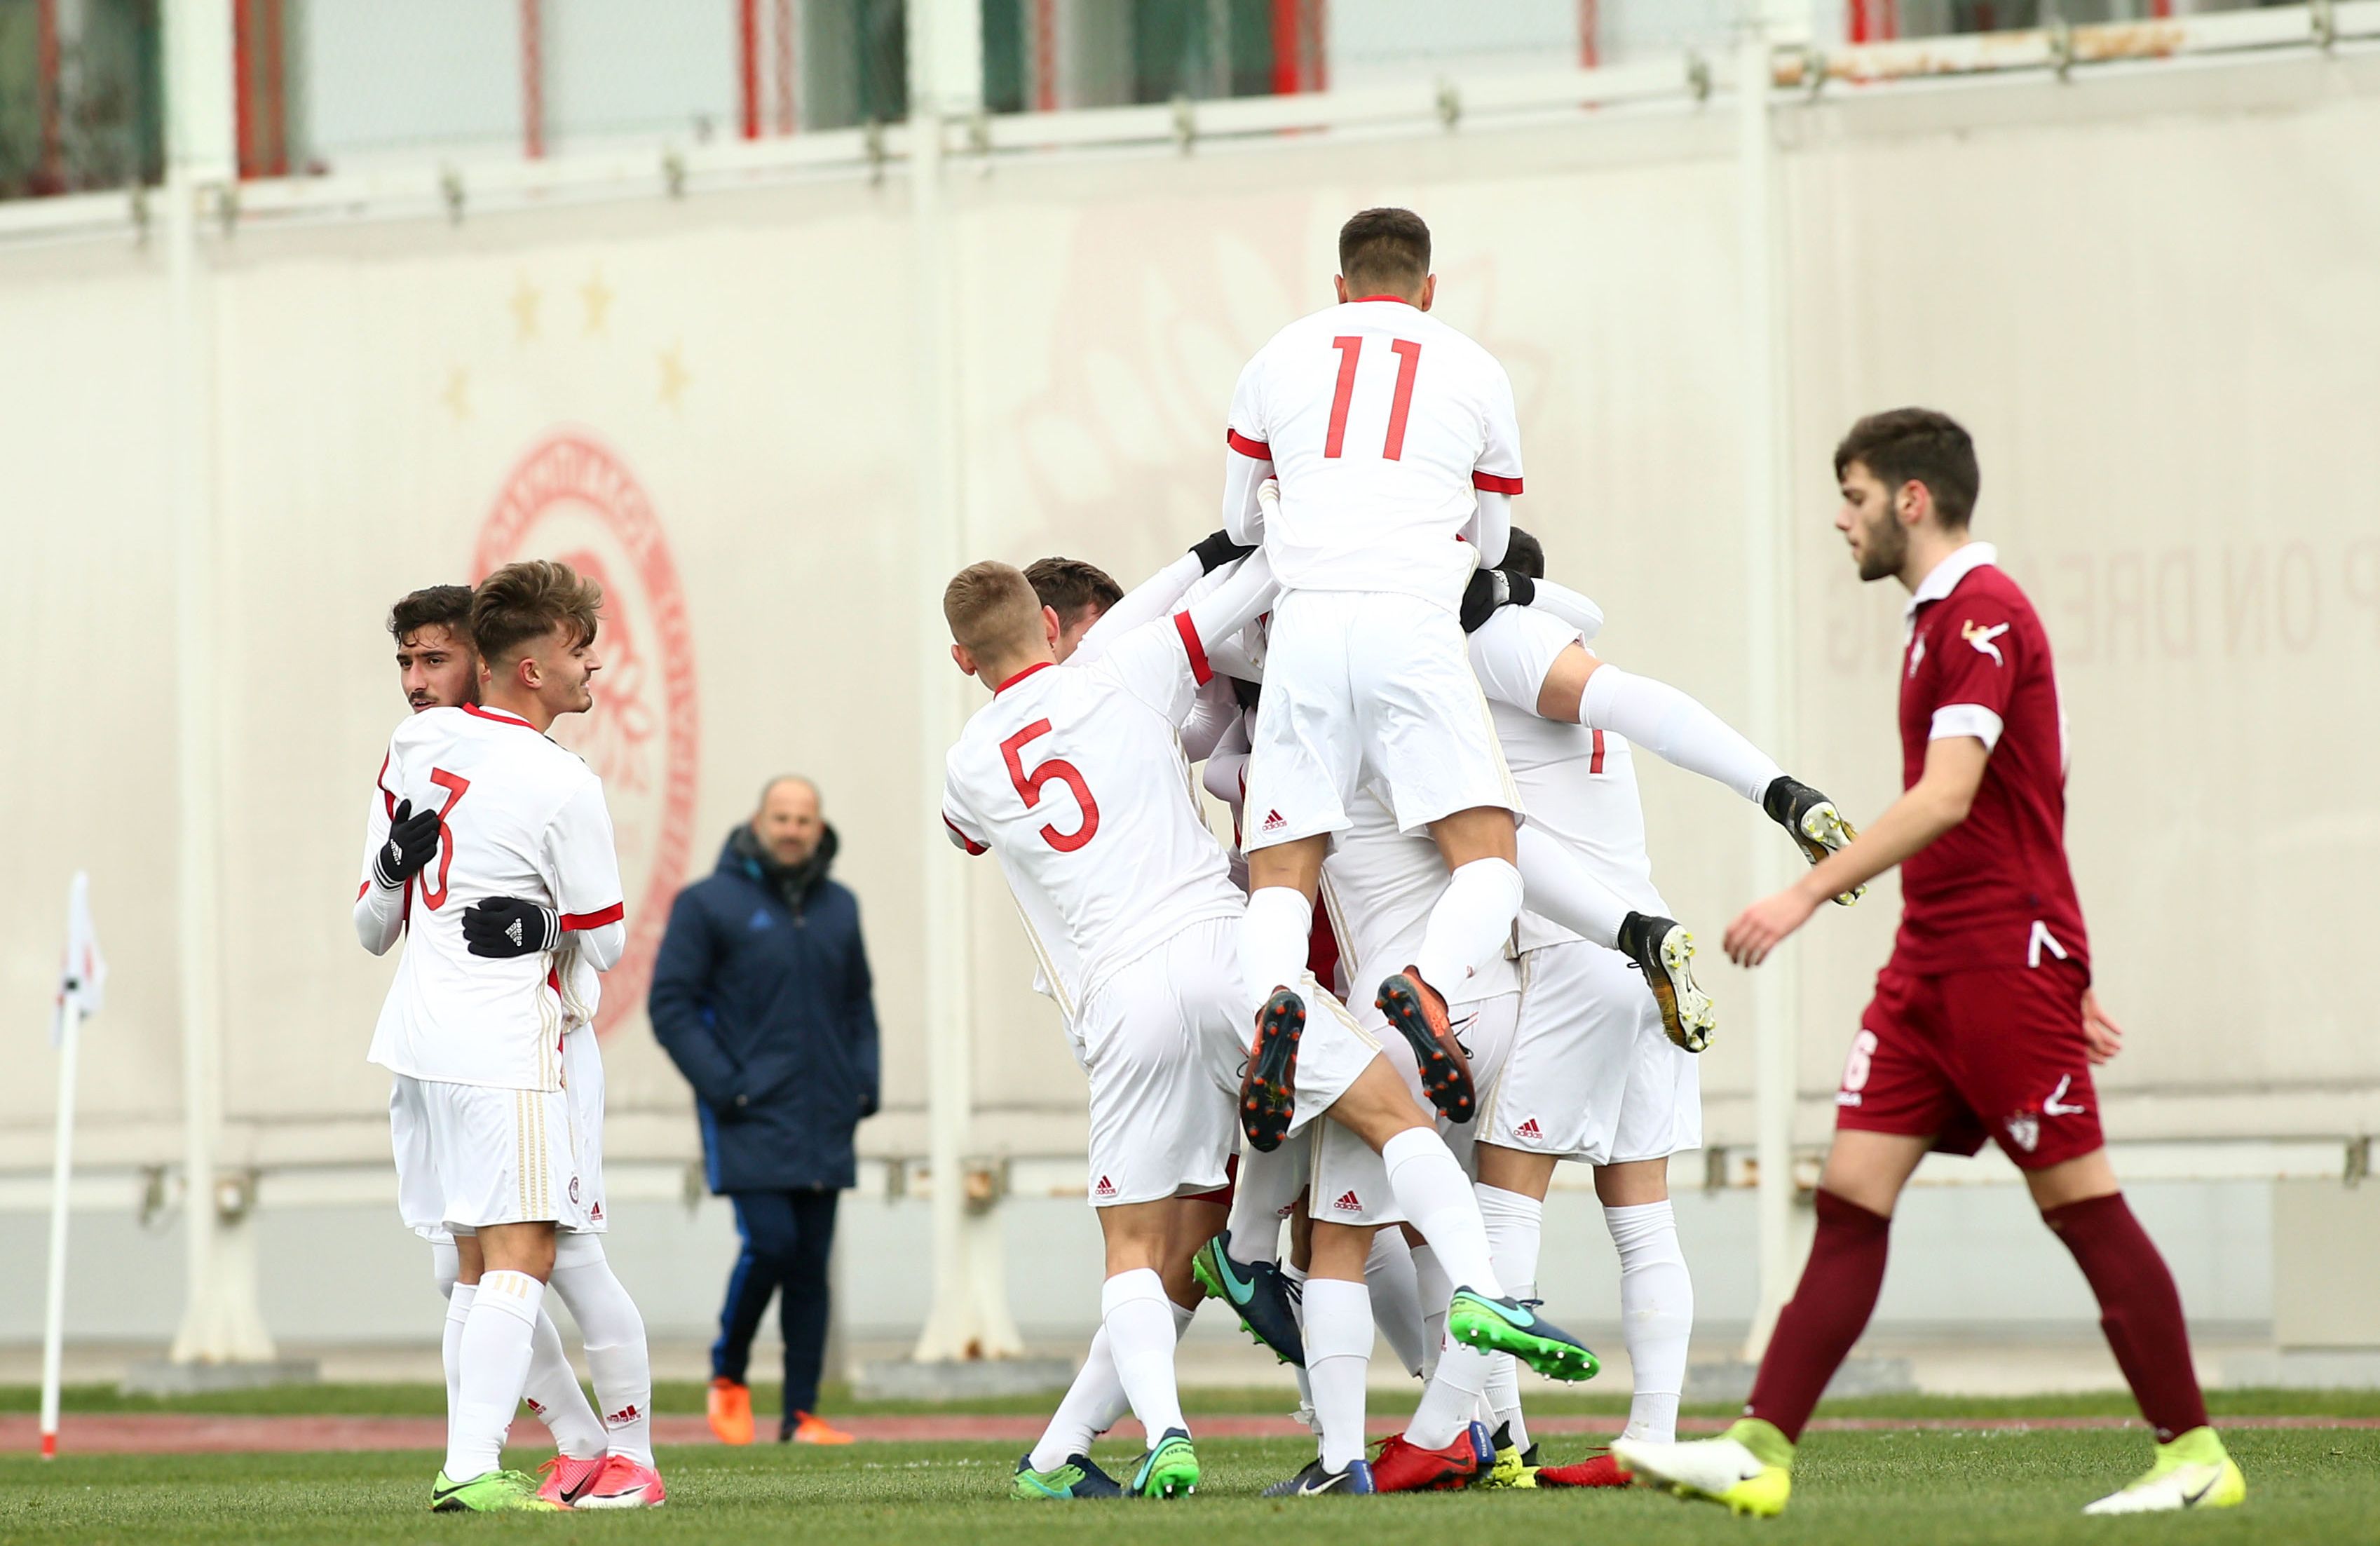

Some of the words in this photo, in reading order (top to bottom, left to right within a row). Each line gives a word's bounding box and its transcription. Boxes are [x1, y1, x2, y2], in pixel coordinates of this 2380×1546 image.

[1324, 336, 1422, 461] 11
[1000, 717, 1099, 852] 5
[1262, 820, 1288, 831] adidas
[1514, 1130, 1543, 1139] adidas
[1333, 1202, 1362, 1212] adidas
